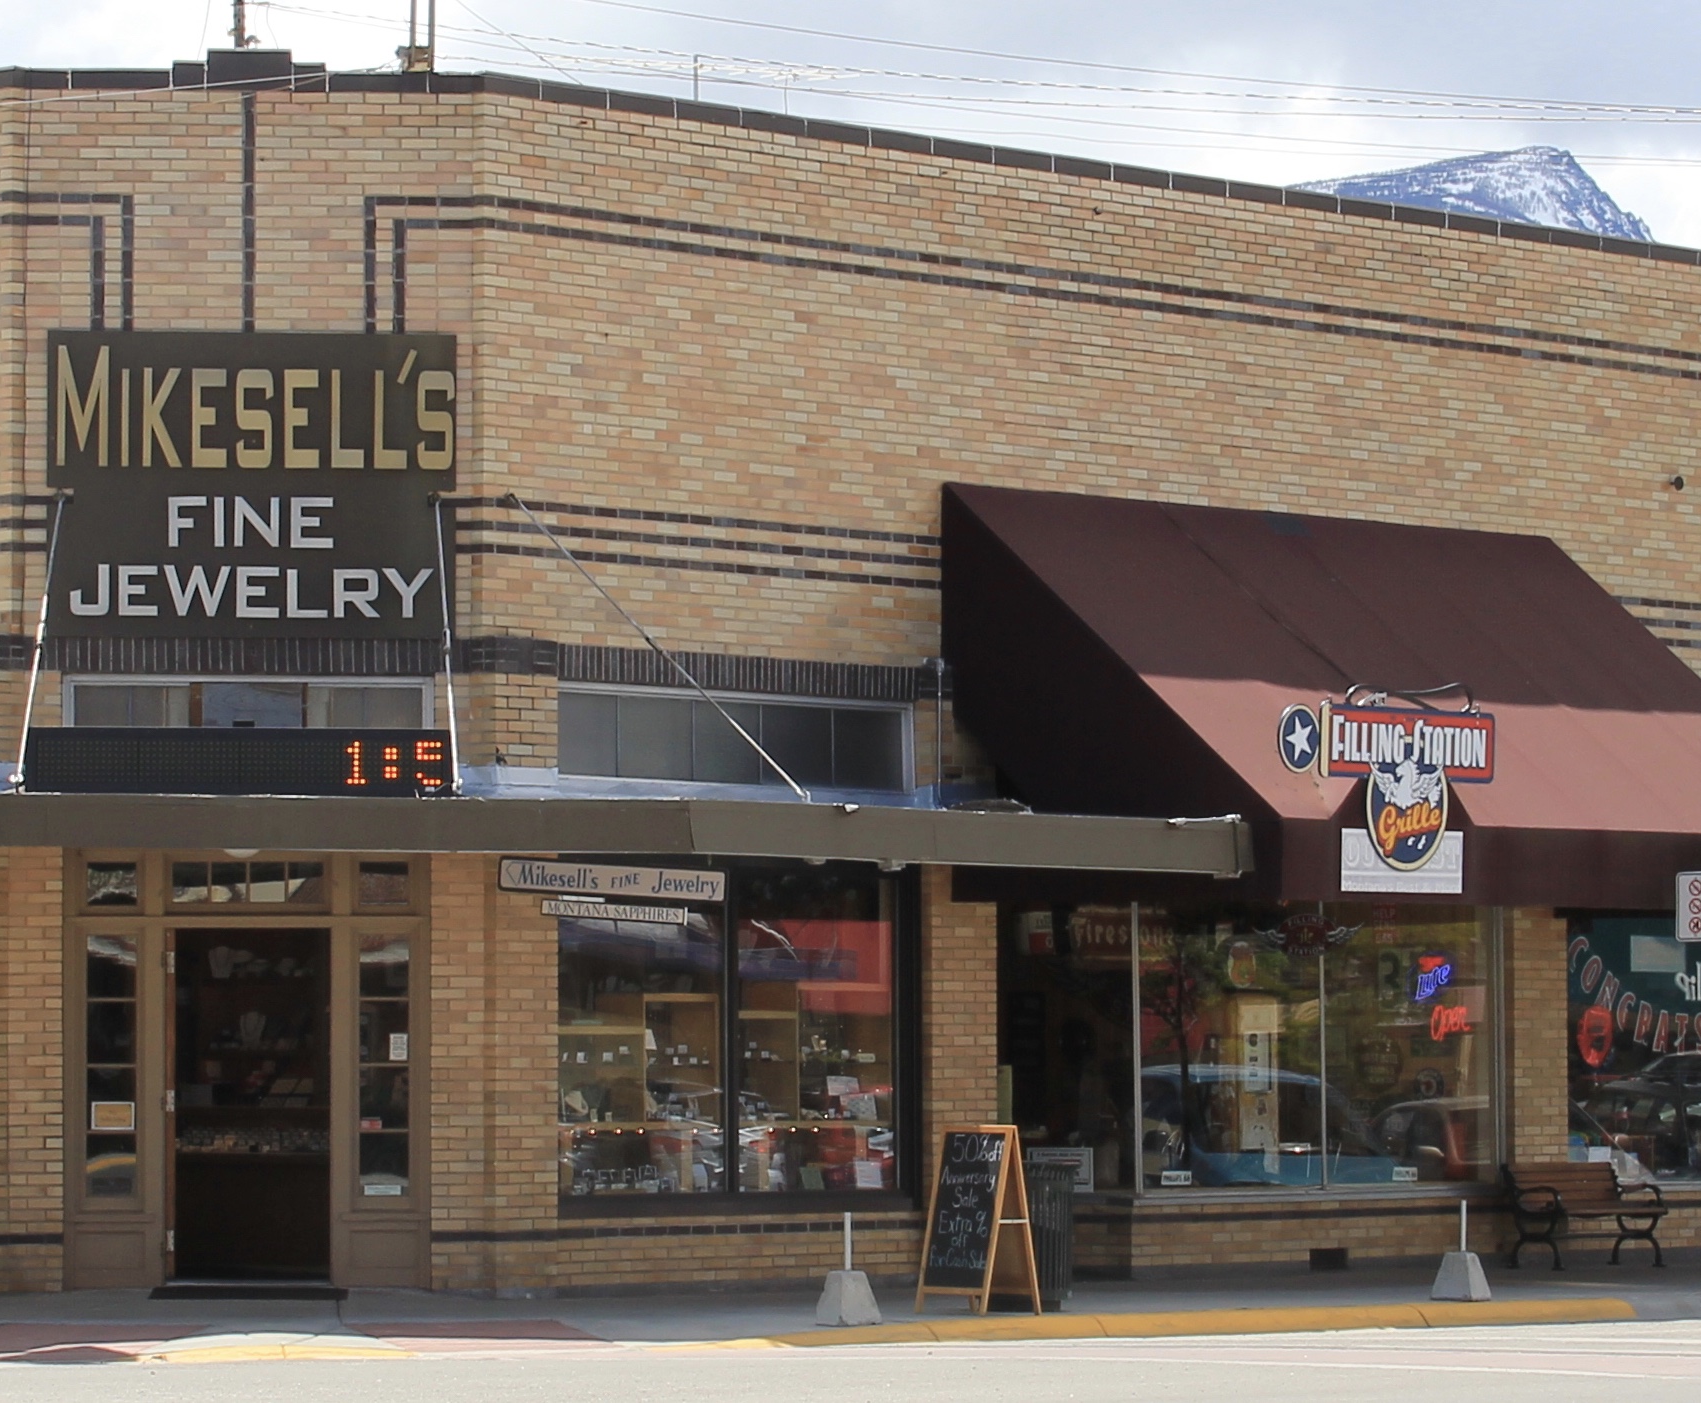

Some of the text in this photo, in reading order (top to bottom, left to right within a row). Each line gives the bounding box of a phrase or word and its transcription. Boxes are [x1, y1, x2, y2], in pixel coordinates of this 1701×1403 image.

[56, 344, 456, 470] MIKESELL'S
[167, 496, 334, 549] FINE
[69, 564, 434, 619] JEWELRY
[1331, 714, 1487, 768] FILLING STATION
[1377, 802, 1442, 857] Grille
[516, 862, 720, 900] Mikesell's FINE Jewelry
[547, 902, 680, 922] MONTANA SAPPHIRES
[1070, 916, 1174, 948] Firesone
[1430, 1004, 1472, 1041] Open
[951, 1186, 979, 1209] Sale
[938, 1210, 973, 1234] Extra
